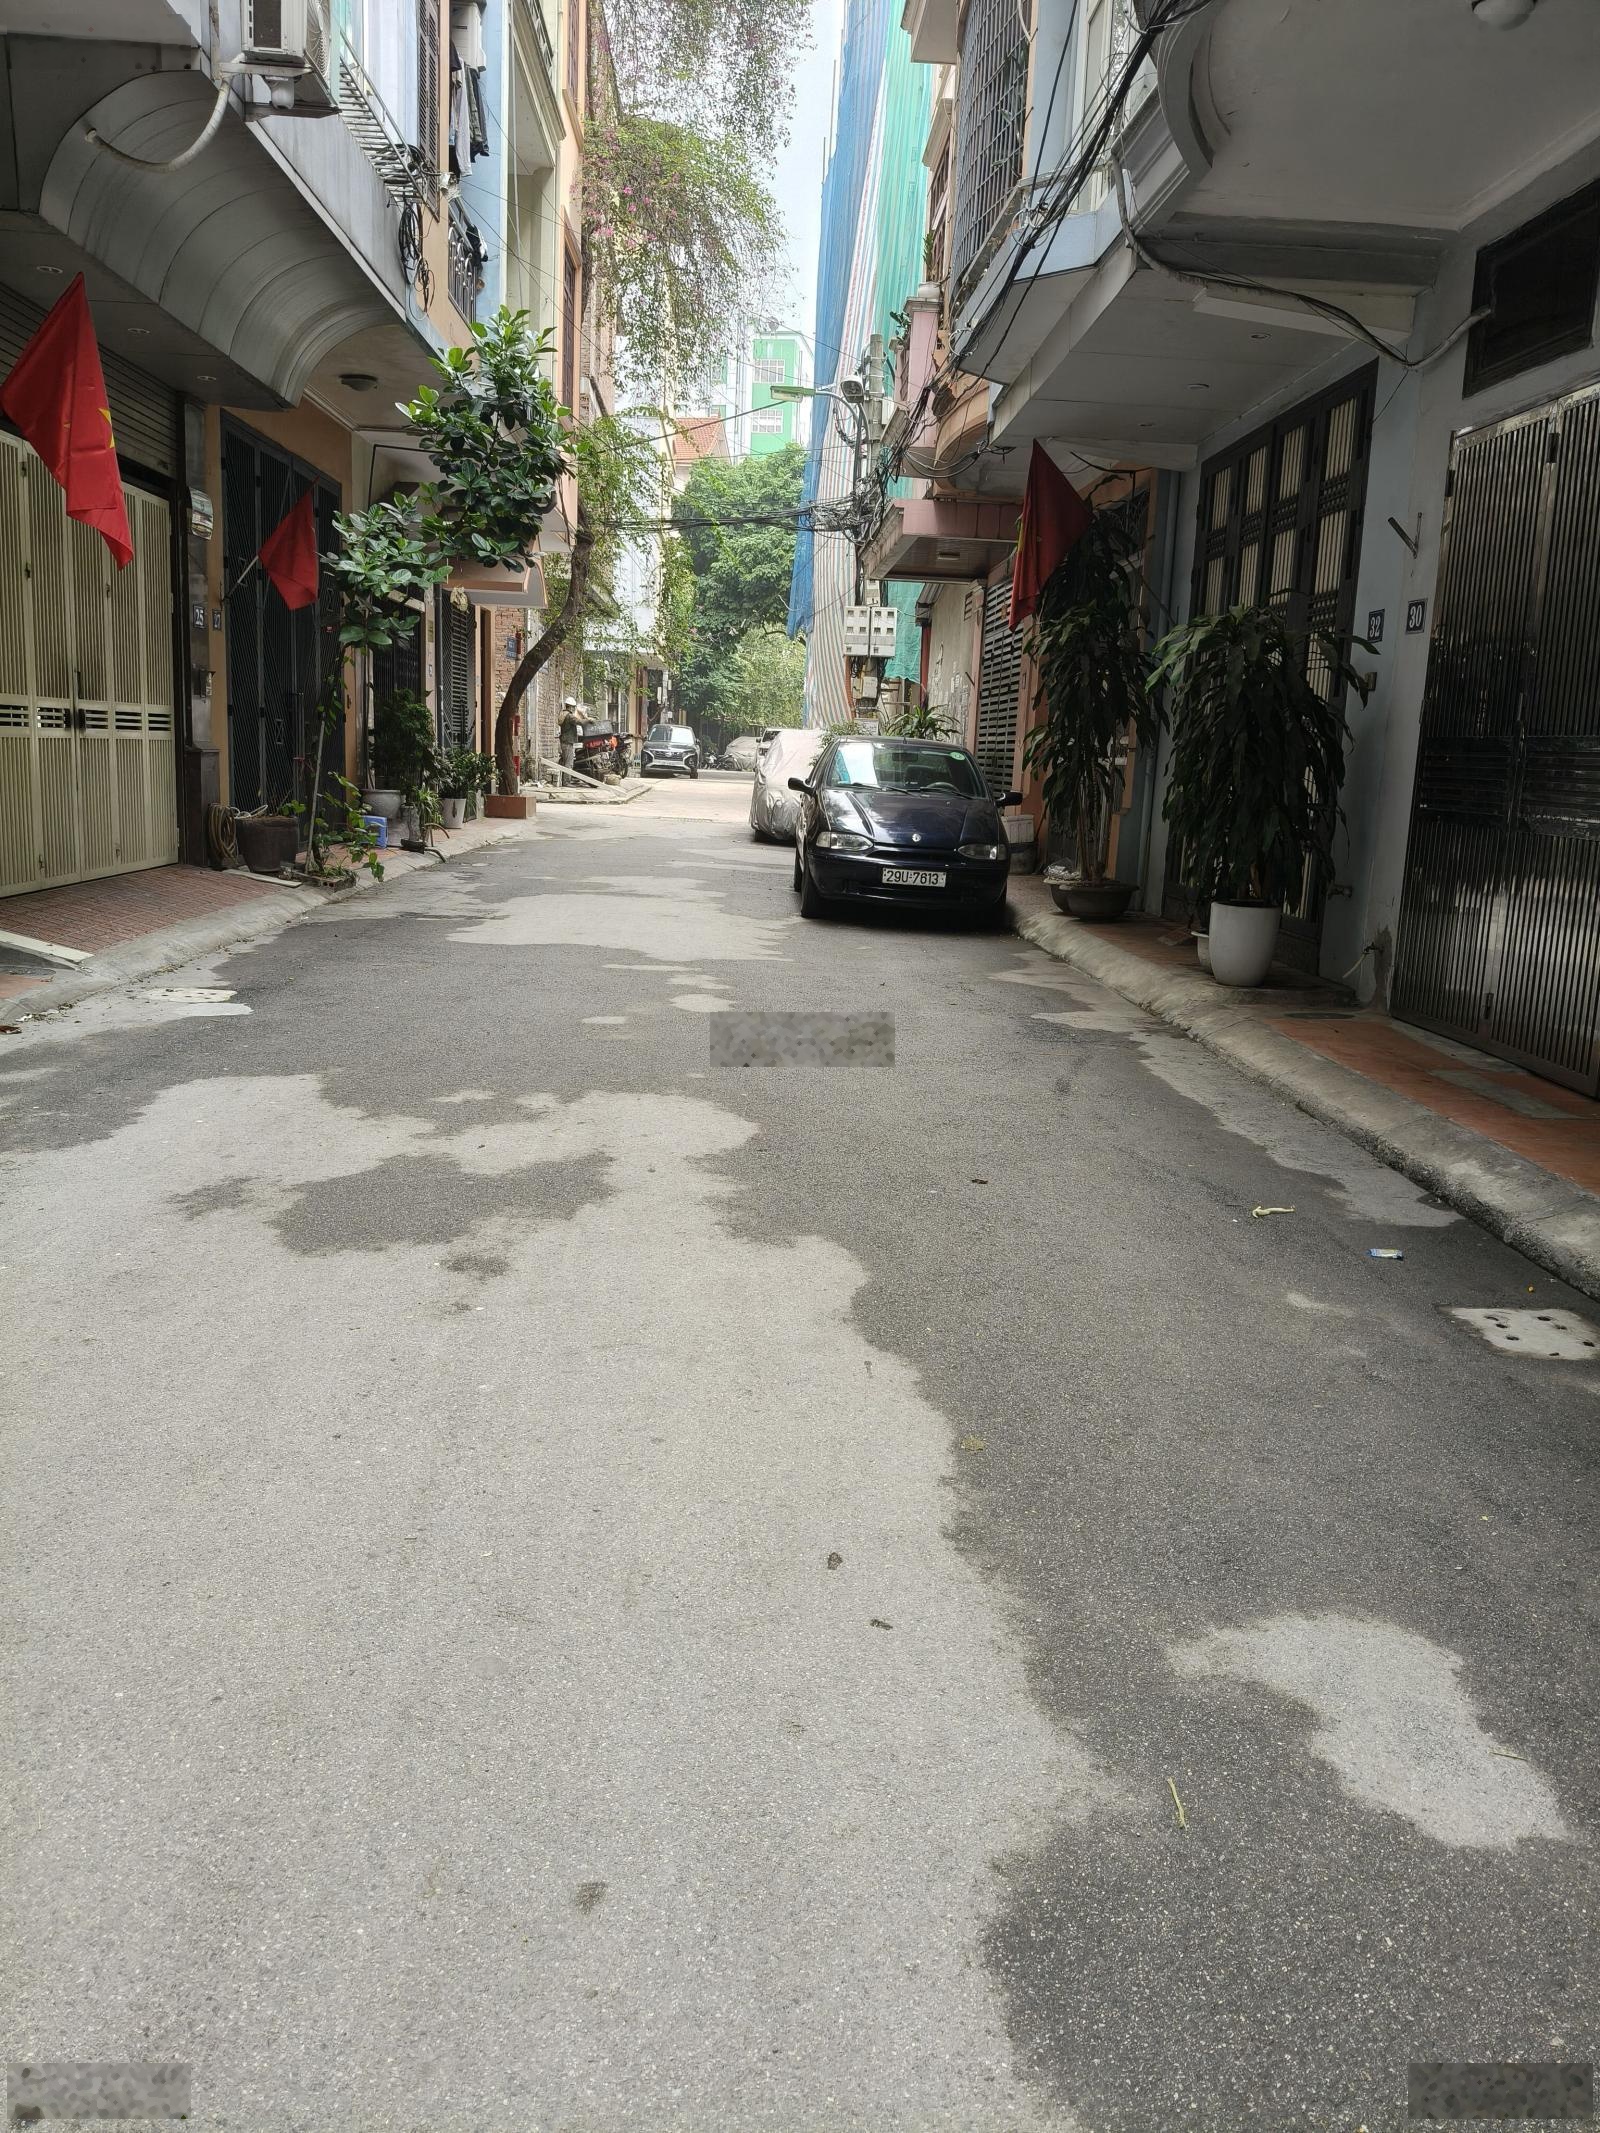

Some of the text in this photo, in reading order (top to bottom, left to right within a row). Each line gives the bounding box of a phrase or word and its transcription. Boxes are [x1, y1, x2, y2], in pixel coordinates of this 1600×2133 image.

[195, 608, 204, 626] 25
[1369, 615, 1381, 637] 32
[1409, 604, 1422, 628] 30
[886, 870, 939, 885] 29U-7613
